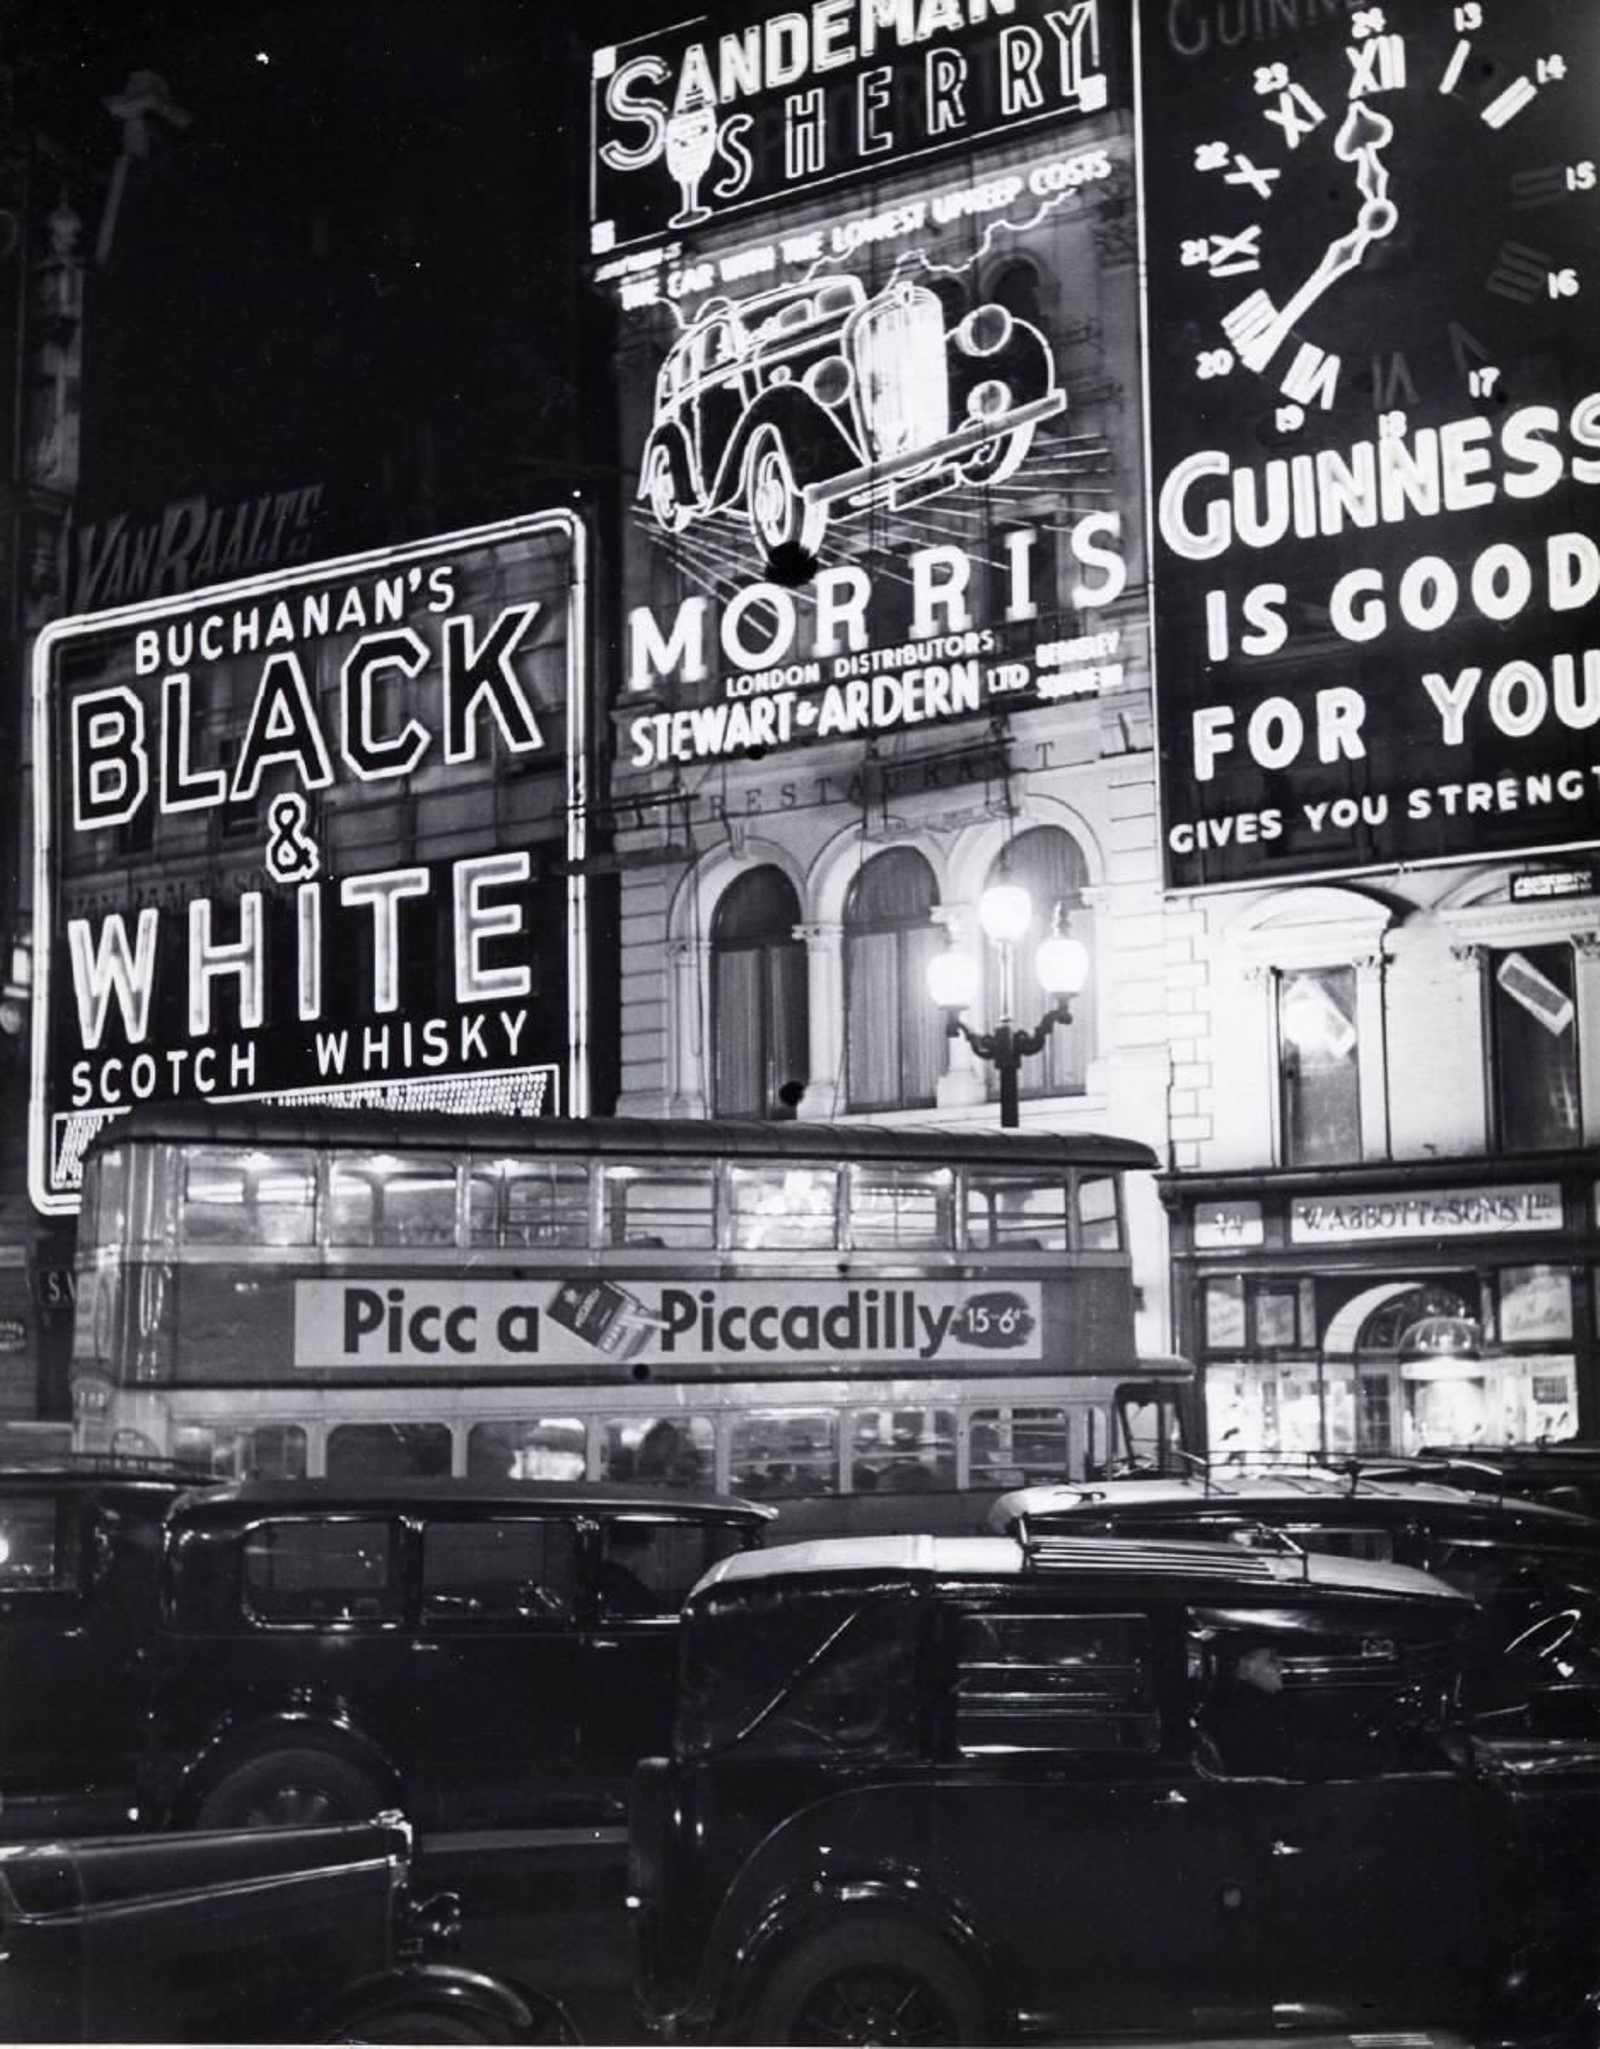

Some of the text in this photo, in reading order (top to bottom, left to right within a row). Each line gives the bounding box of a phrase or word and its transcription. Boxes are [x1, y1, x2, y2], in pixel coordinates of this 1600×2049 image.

[1454, 2, 1483, 32] 13
[713, 2, 1094, 198] SHERRY
[1345, 34, 1406, 100] XII
[1537, 54, 1567, 84] 14
[1263, 83, 1327, 150] XI
[1029, 150, 1112, 196] COSTS
[1224, 154, 1281, 199] X
[1565, 161, 1597, 191] 15
[1548, 269, 1580, 299] 16
[1469, 367, 1500, 398] 17
[136, 566, 454, 675] BUCHANAN'S
[628, 511, 1127, 691] MORRIS
[1206, 532, 1600, 661] IS GOOD
[726, 663, 820, 698] LONDON
[834, 631, 995, 679] DISTRIBUTORS
[987, 664, 1030, 694] LTD
[72, 602, 543, 830] BLACK
[1193, 649, 1600, 781] FOR YOU
[266, 793, 319, 882] &
[1169, 809, 1283, 854] GIVES
[1304, 794, 1388, 832] YOU
[67, 852, 531, 1049] WHITE
[72, 1010, 527, 1106] SCOTCH WHISKY
[344, 1288, 477, 1353] Picc
[497, 1305, 539, 1353] a
[662, 1289, 955, 1358] Piccadilly
